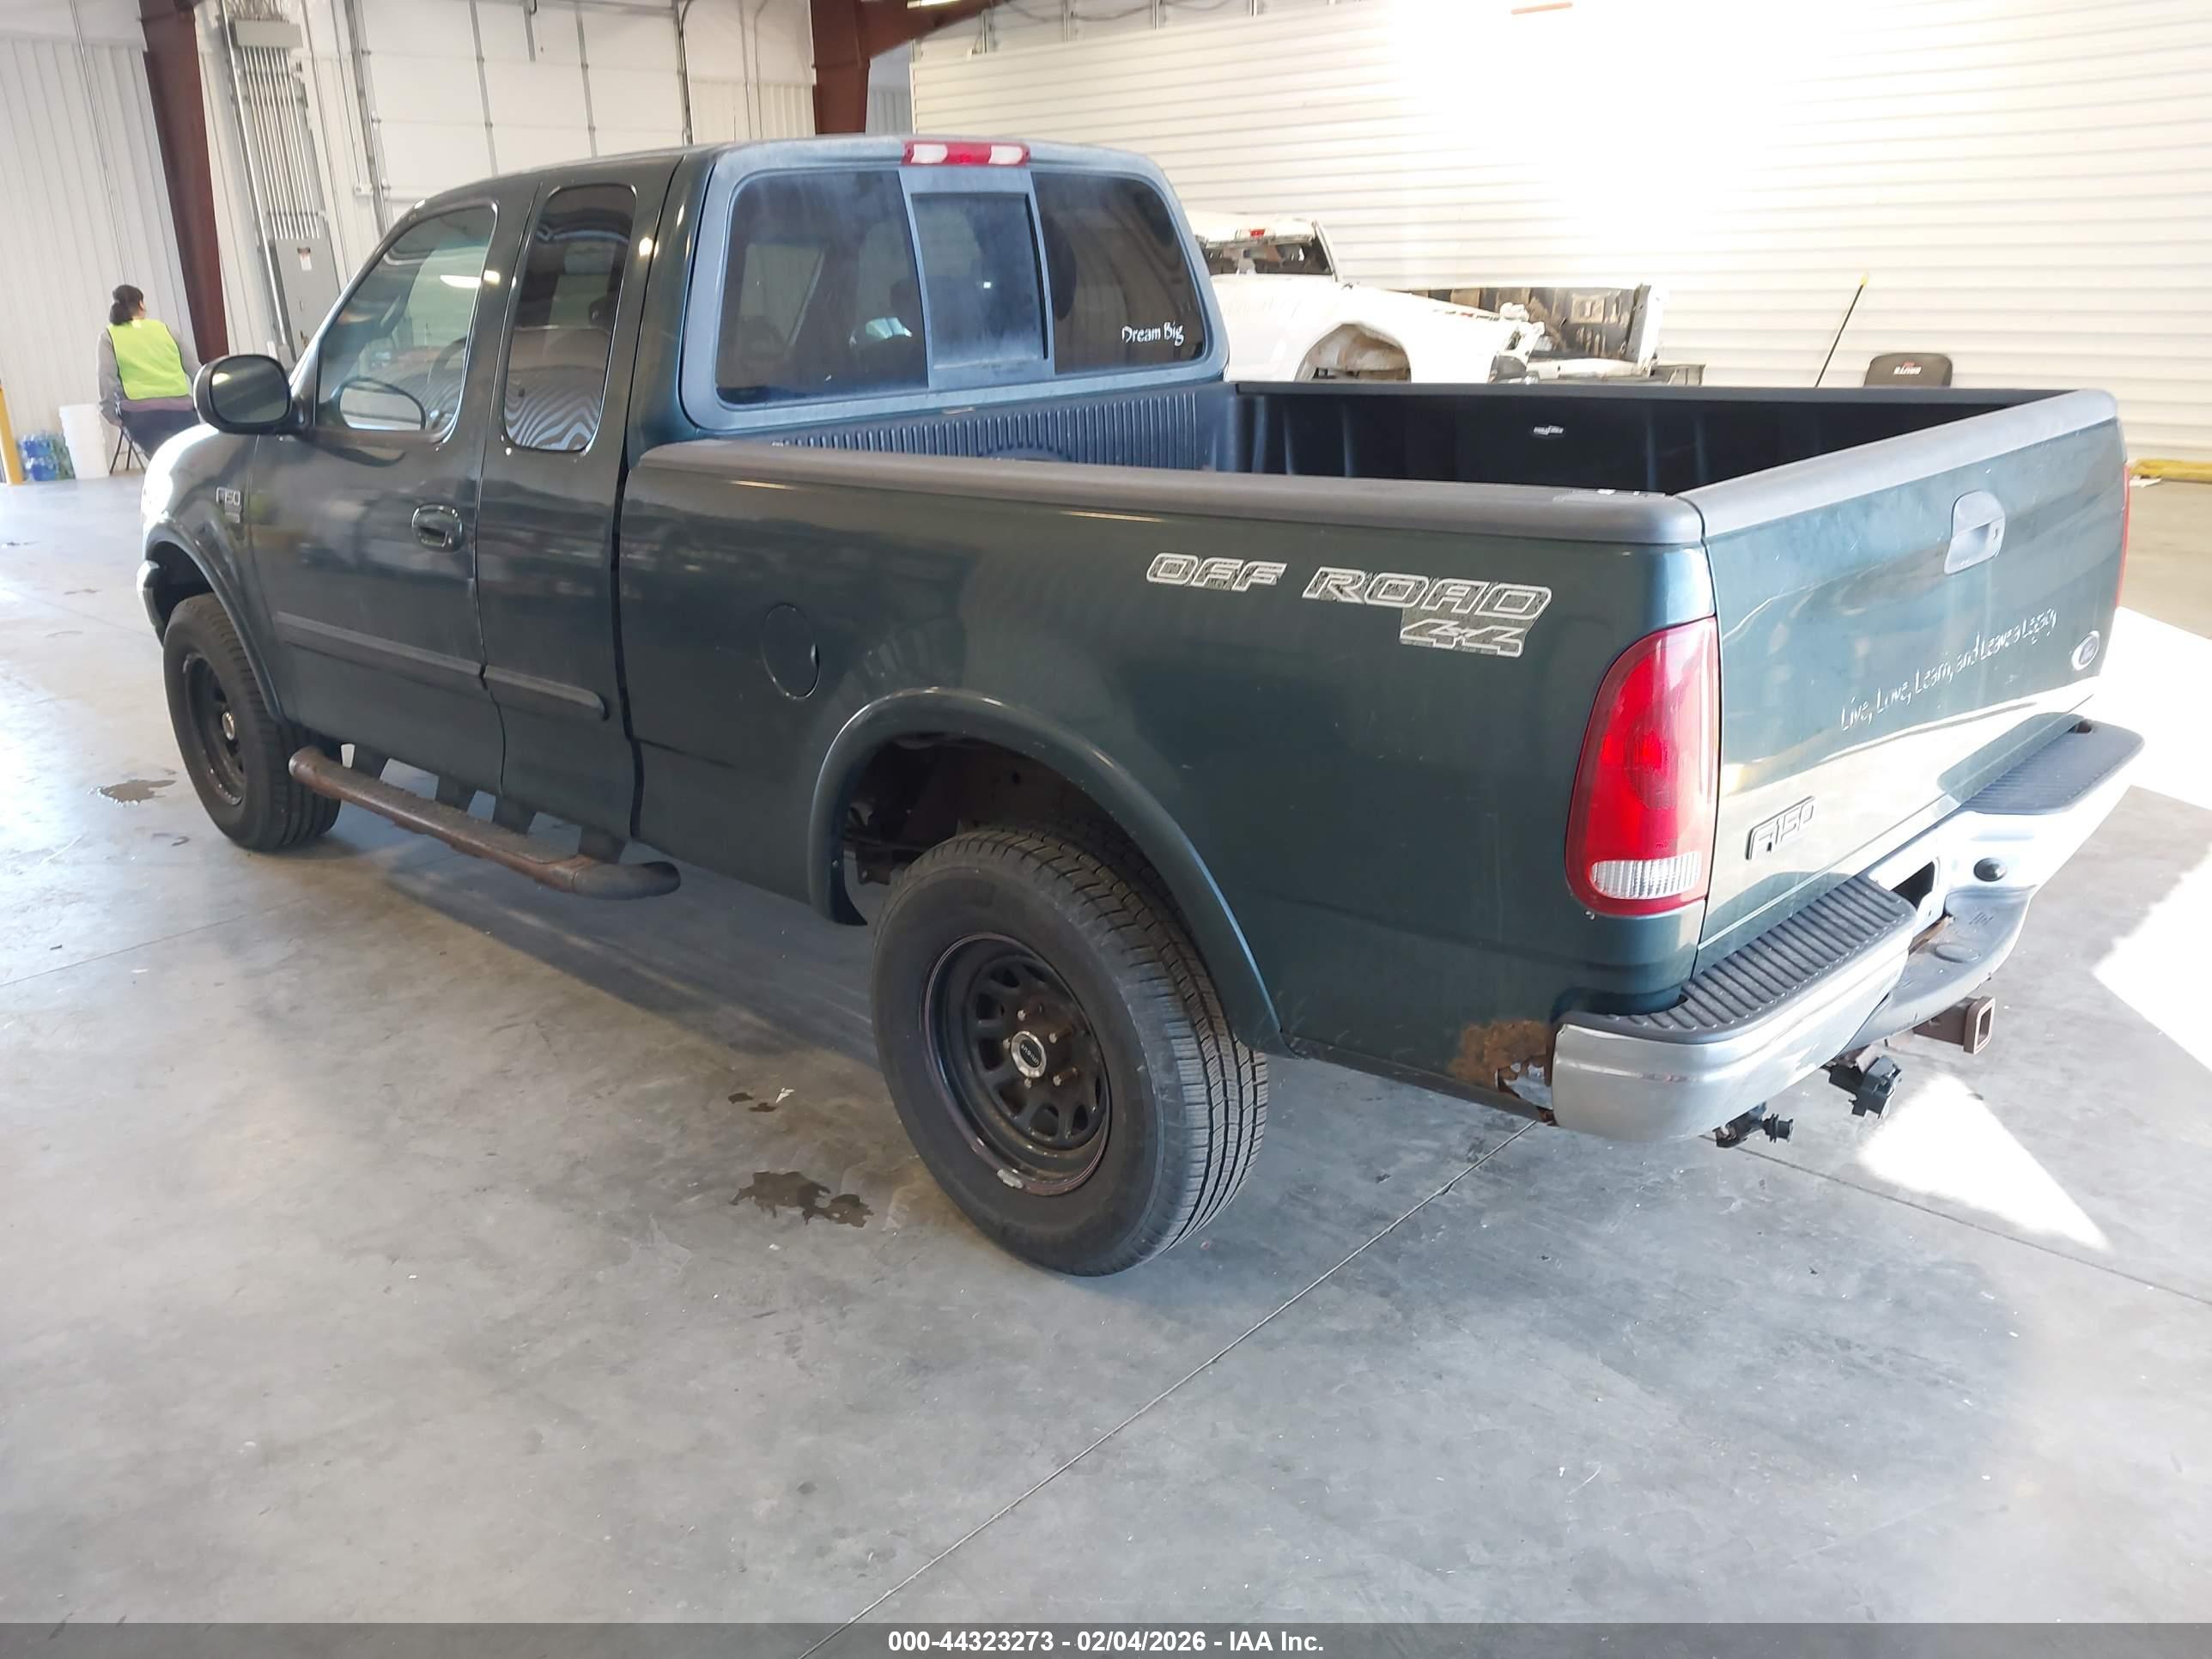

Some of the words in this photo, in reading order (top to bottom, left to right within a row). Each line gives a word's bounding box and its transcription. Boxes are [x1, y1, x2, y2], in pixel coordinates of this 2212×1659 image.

[1121, 325, 1161, 343] Dream
[1164, 319, 1184, 347] Big
[1146, 552, 1287, 592] OFF
[1302, 565, 1553, 620] ROAD
